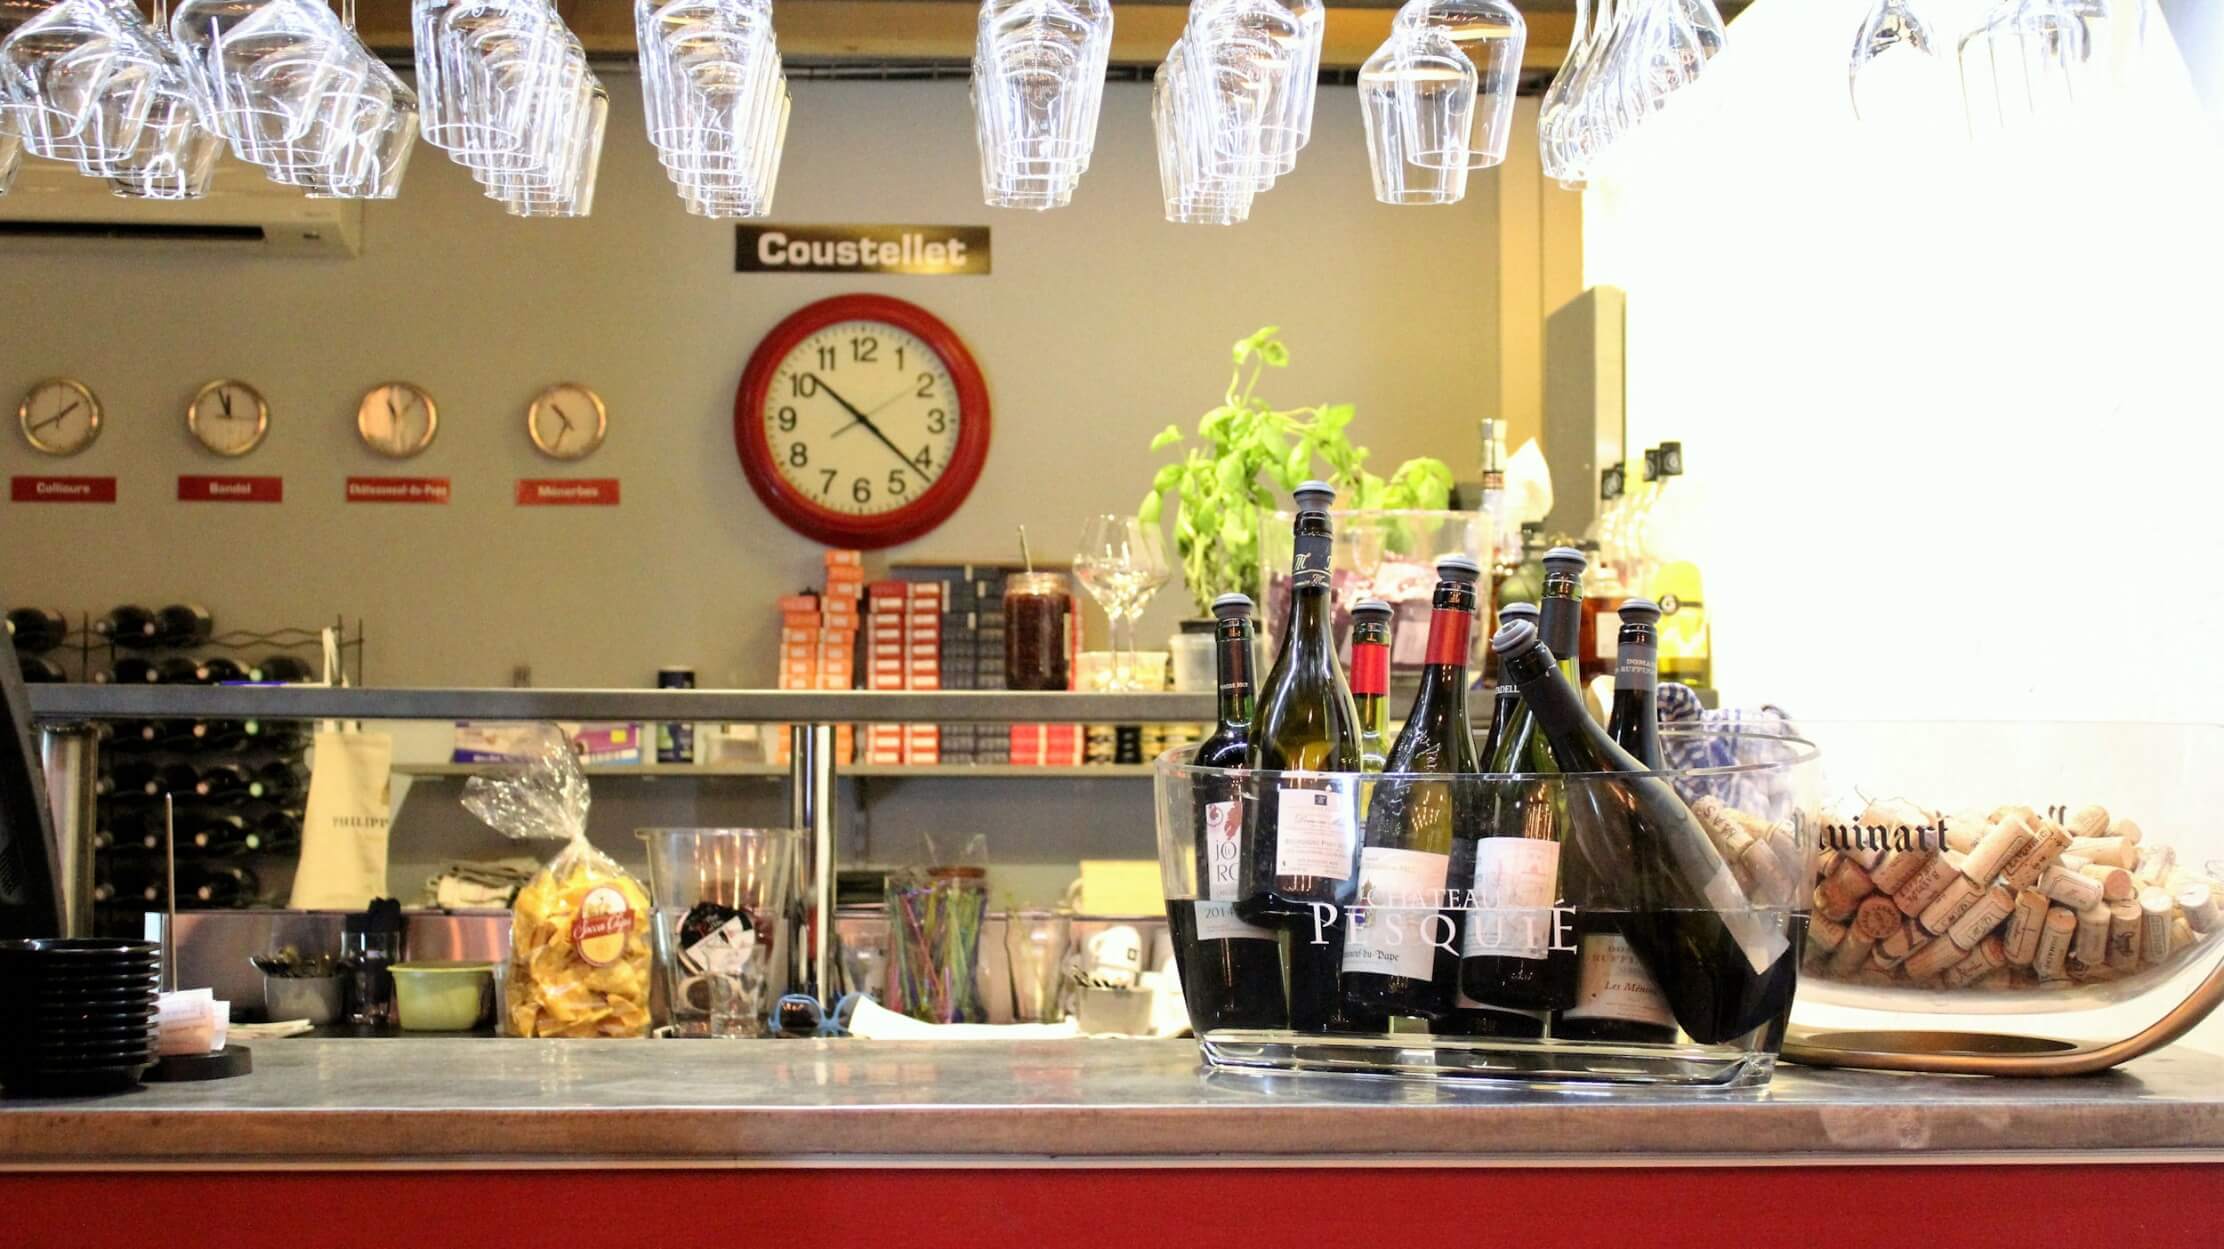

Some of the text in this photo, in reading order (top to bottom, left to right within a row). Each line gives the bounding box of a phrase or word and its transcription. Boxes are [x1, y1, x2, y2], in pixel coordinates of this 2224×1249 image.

[757, 231, 967, 267] Coustellet
[816, 346, 836, 371] 11
[850, 337, 878, 362] 12
[896, 346, 904, 371] 1
[789, 373, 816, 398] 10
[916, 373, 935, 398] 2
[778, 406, 797, 432] 9
[927, 408, 945, 434] 3
[789, 442, 808, 467] 8
[915, 445, 932, 469] 4
[820, 469, 837, 495] 7
[853, 477, 871, 503] 6
[887, 469, 906, 495] 5
[1307, 898, 1578, 958] PESQUIÉ
